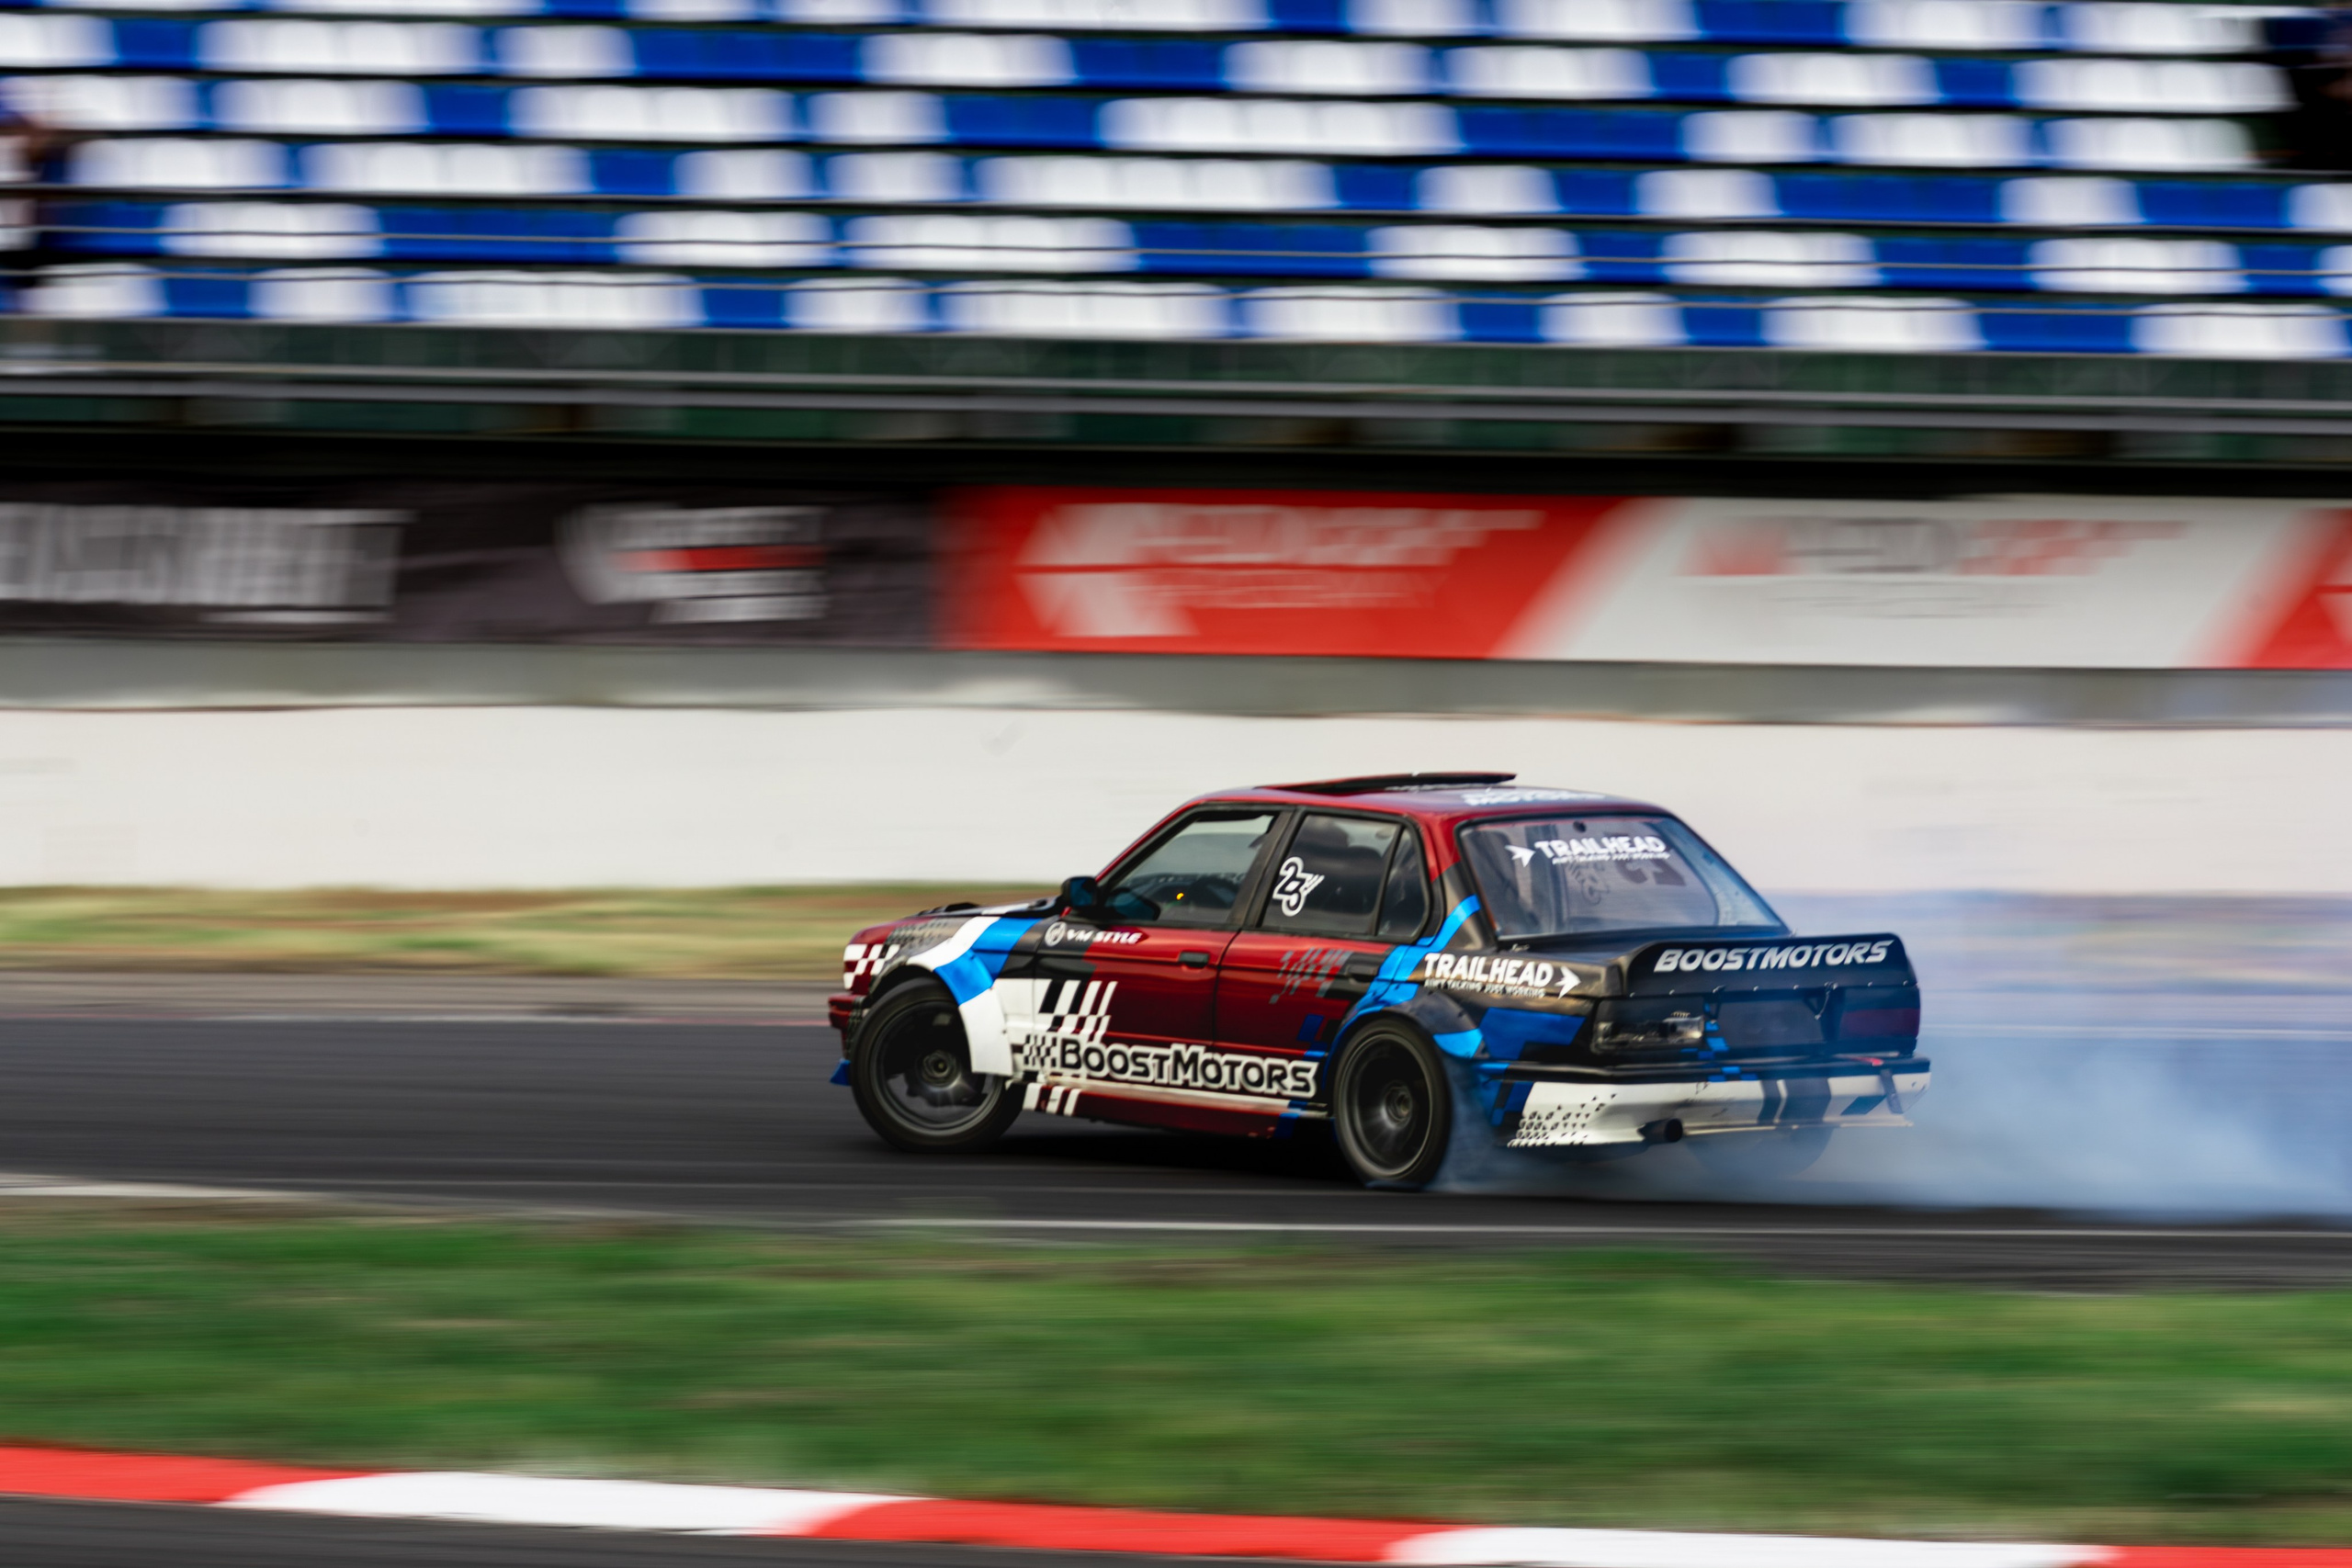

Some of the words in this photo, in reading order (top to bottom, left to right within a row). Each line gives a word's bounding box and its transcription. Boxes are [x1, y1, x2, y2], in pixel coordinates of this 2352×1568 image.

[1534, 836, 1667, 859] TRAILHEAD
[1424, 953, 1554, 987] TRAILHEAD
[1654, 940, 1894, 973] BOOSTMOTORS
